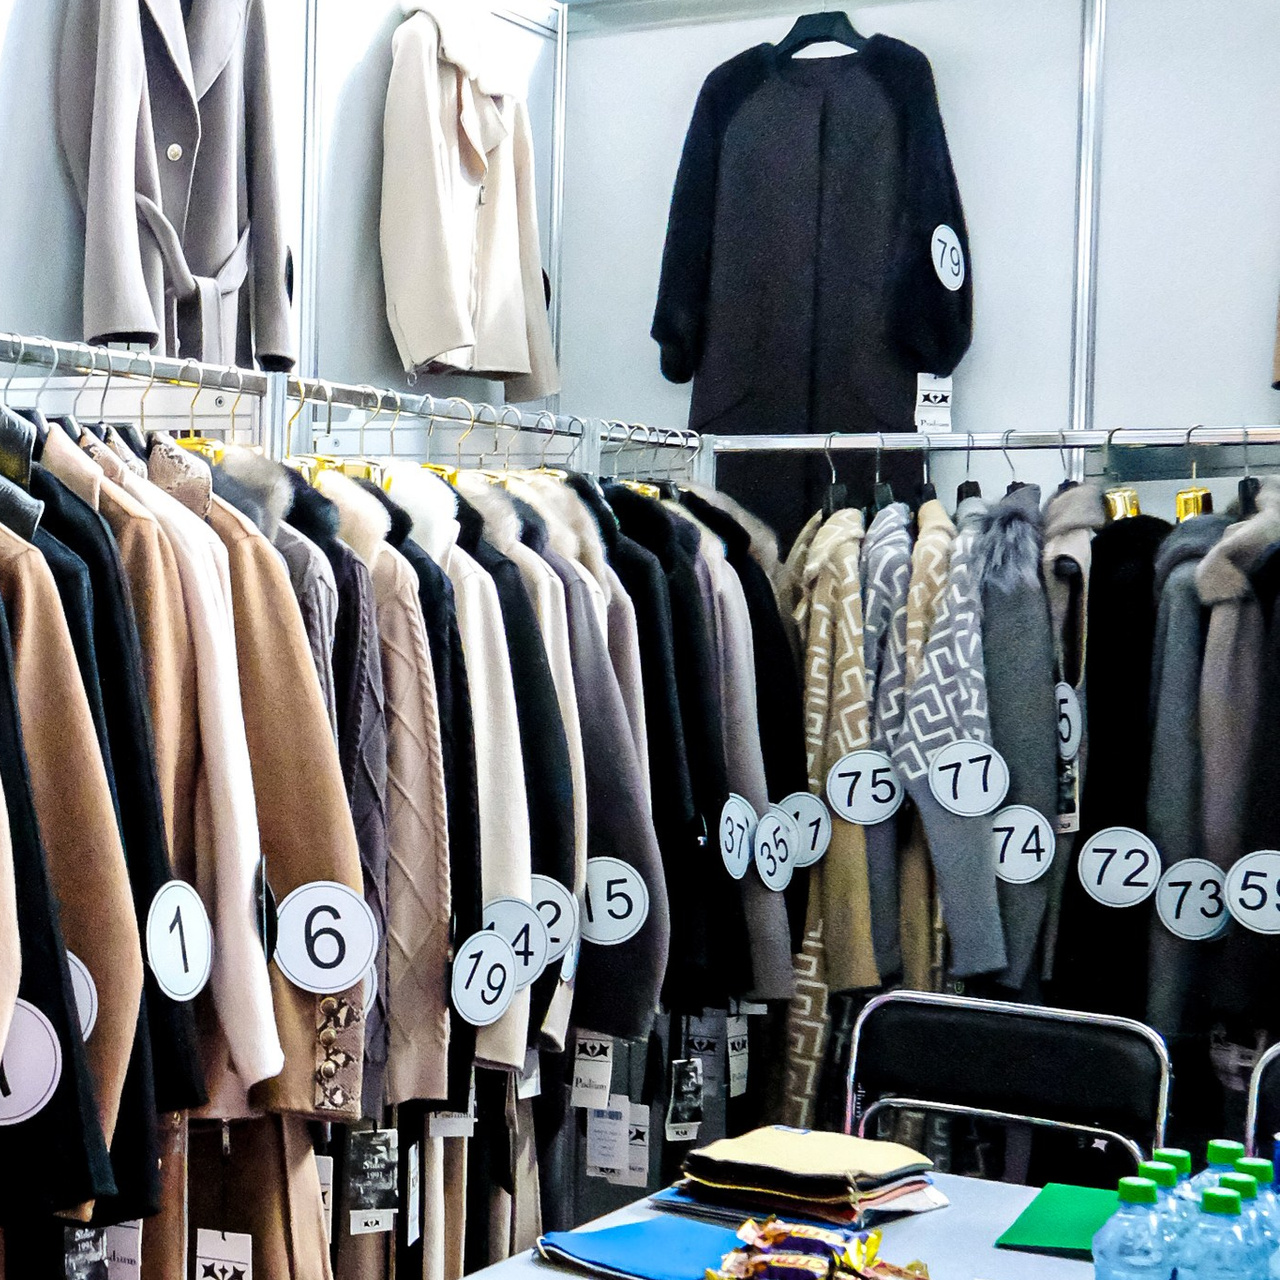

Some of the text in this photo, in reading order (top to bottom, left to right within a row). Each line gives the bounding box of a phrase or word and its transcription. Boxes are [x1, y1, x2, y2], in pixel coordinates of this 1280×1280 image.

[937, 238, 960, 277] 79
[838, 767, 896, 808] 75
[938, 754, 992, 800] 77
[725, 816, 745, 860] 37
[761, 826, 789, 877] 35
[992, 825, 1045, 863] 74
[1091, 848, 1149, 887] 72
[585, 878, 633, 923] 15
[1168, 879, 1224, 920] 73
[170, 905, 190, 974] 1
[303, 905, 347, 970] 6
[484, 921, 534, 966] 4
[465, 950, 507, 1005] 19
